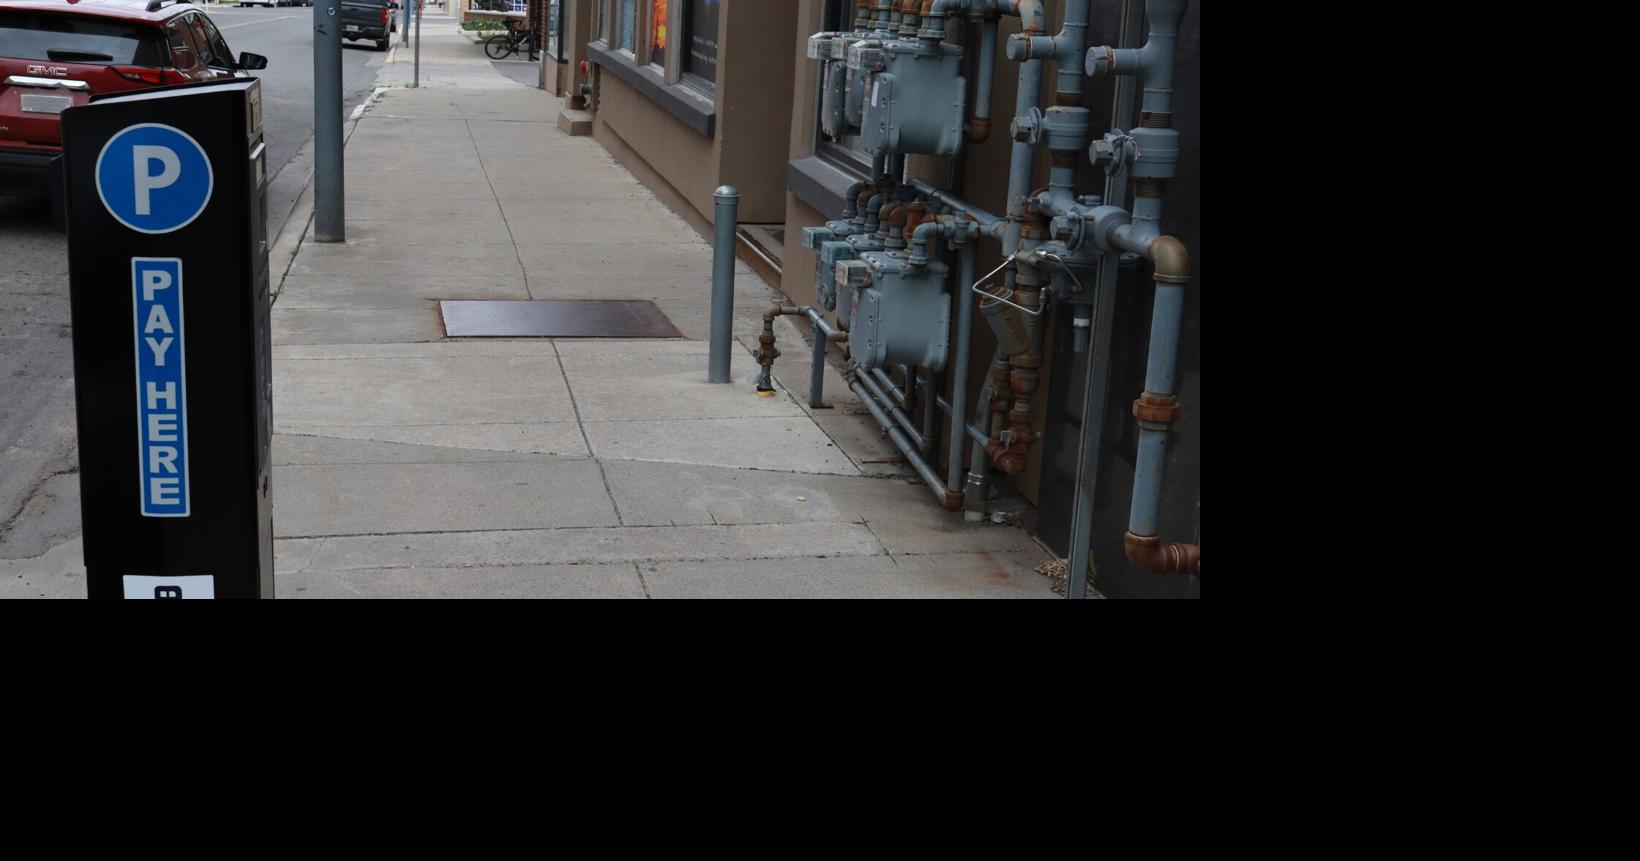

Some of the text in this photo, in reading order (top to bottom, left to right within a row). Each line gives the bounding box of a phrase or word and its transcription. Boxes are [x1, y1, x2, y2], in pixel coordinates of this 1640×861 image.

[27, 65, 68, 76] GMC
[133, 145, 181, 215] P
[142, 270, 180, 505] PAY HERE
